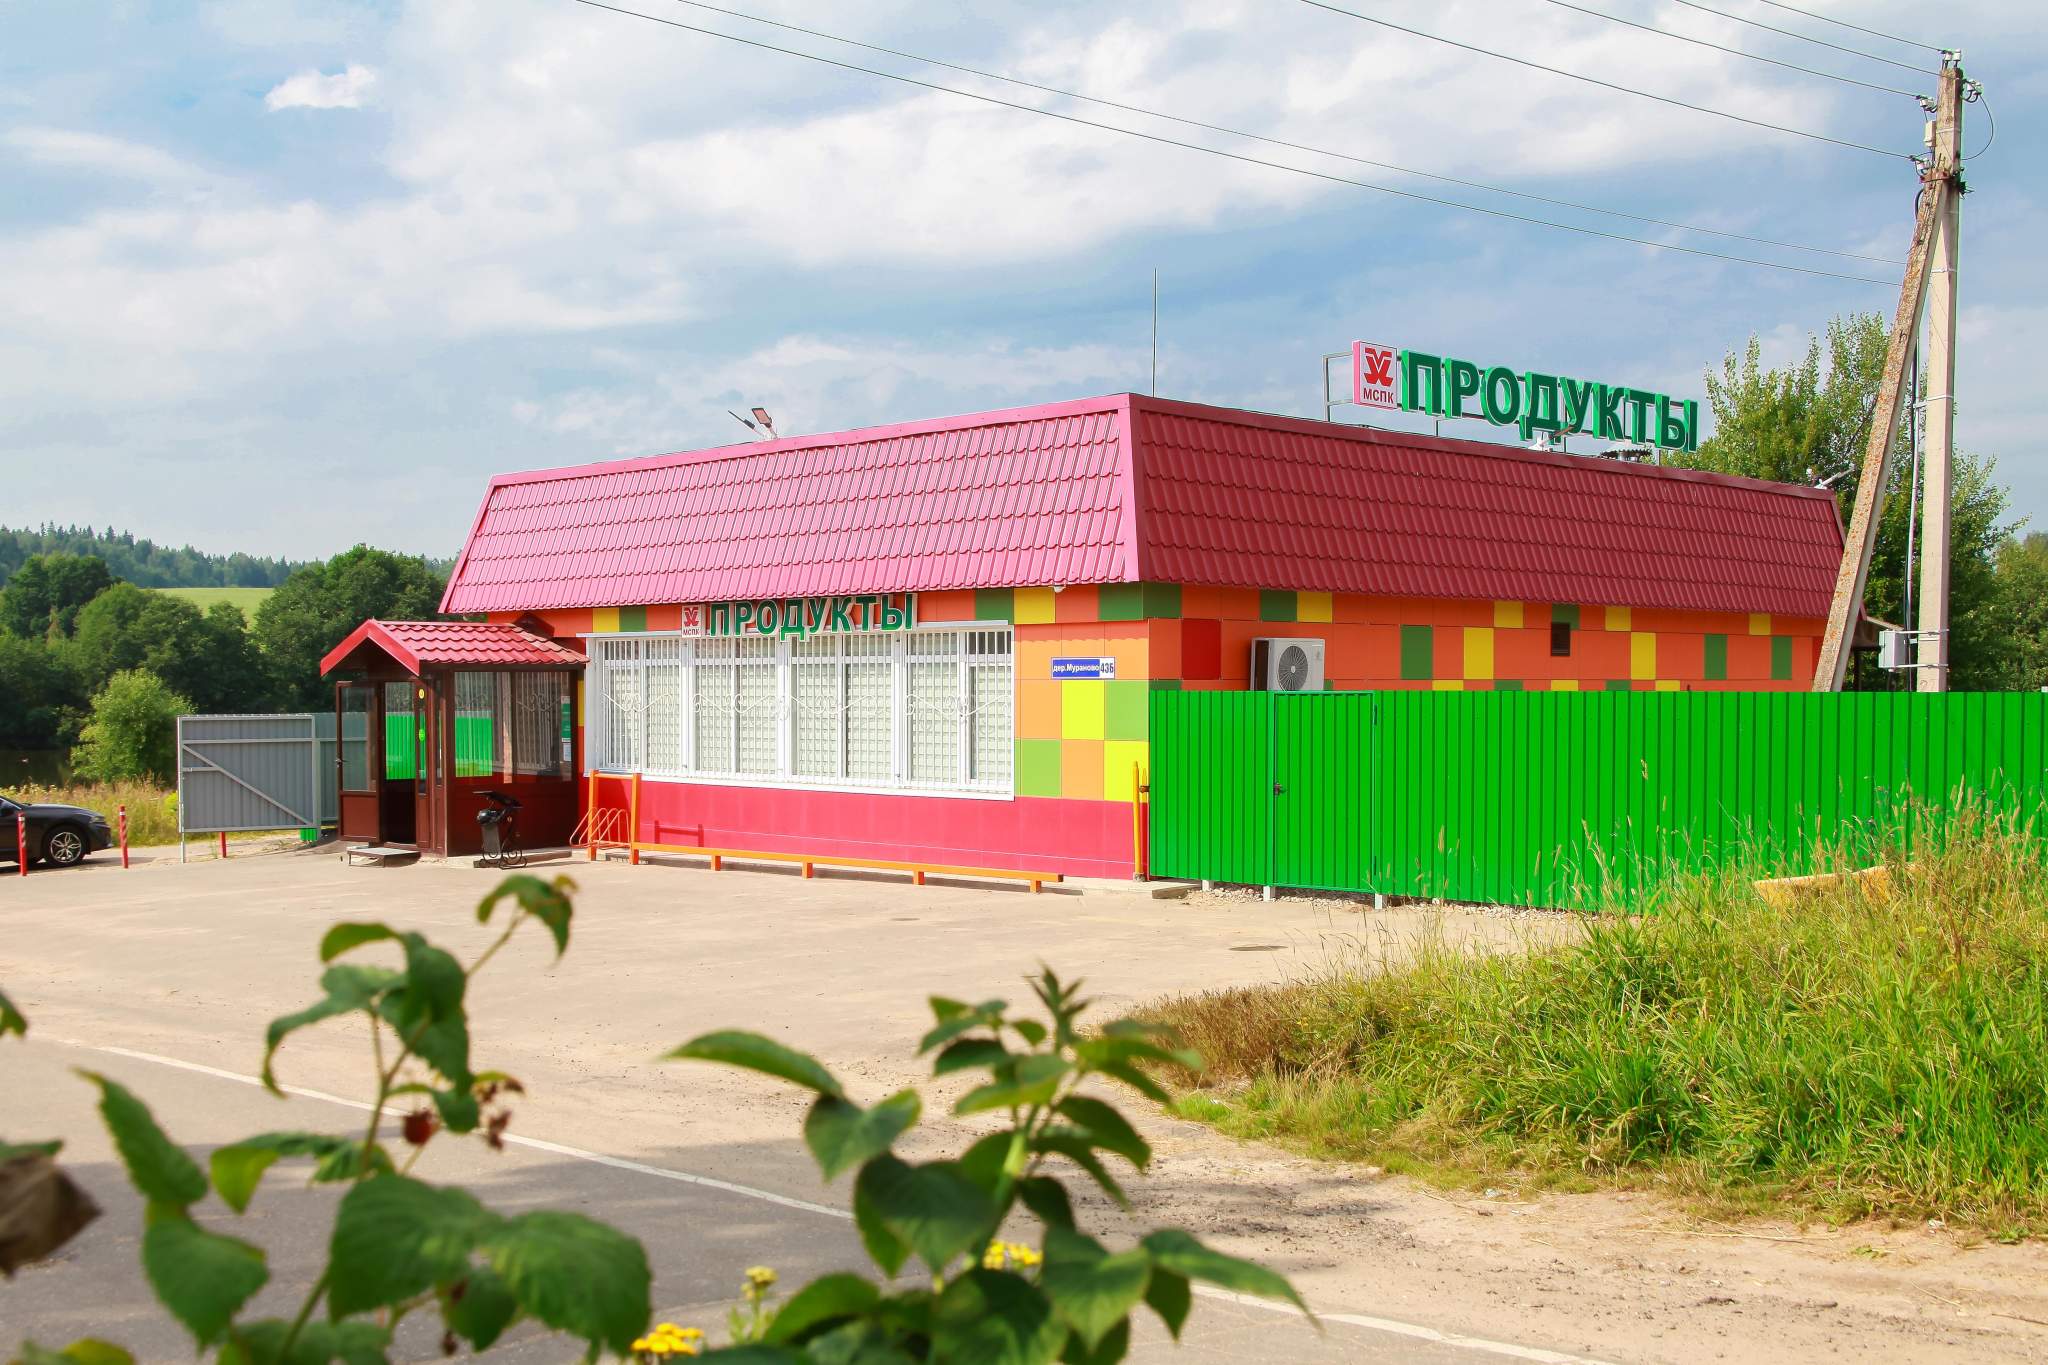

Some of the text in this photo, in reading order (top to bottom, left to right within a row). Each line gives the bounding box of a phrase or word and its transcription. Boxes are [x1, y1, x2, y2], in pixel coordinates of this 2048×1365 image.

[1363, 387, 1394, 404] МСПК
[1401, 349, 1698, 452] ПРОДУКТЫ
[683, 628, 700, 636] МСПК
[709, 593, 914, 642] ПРОДУКТЫ
